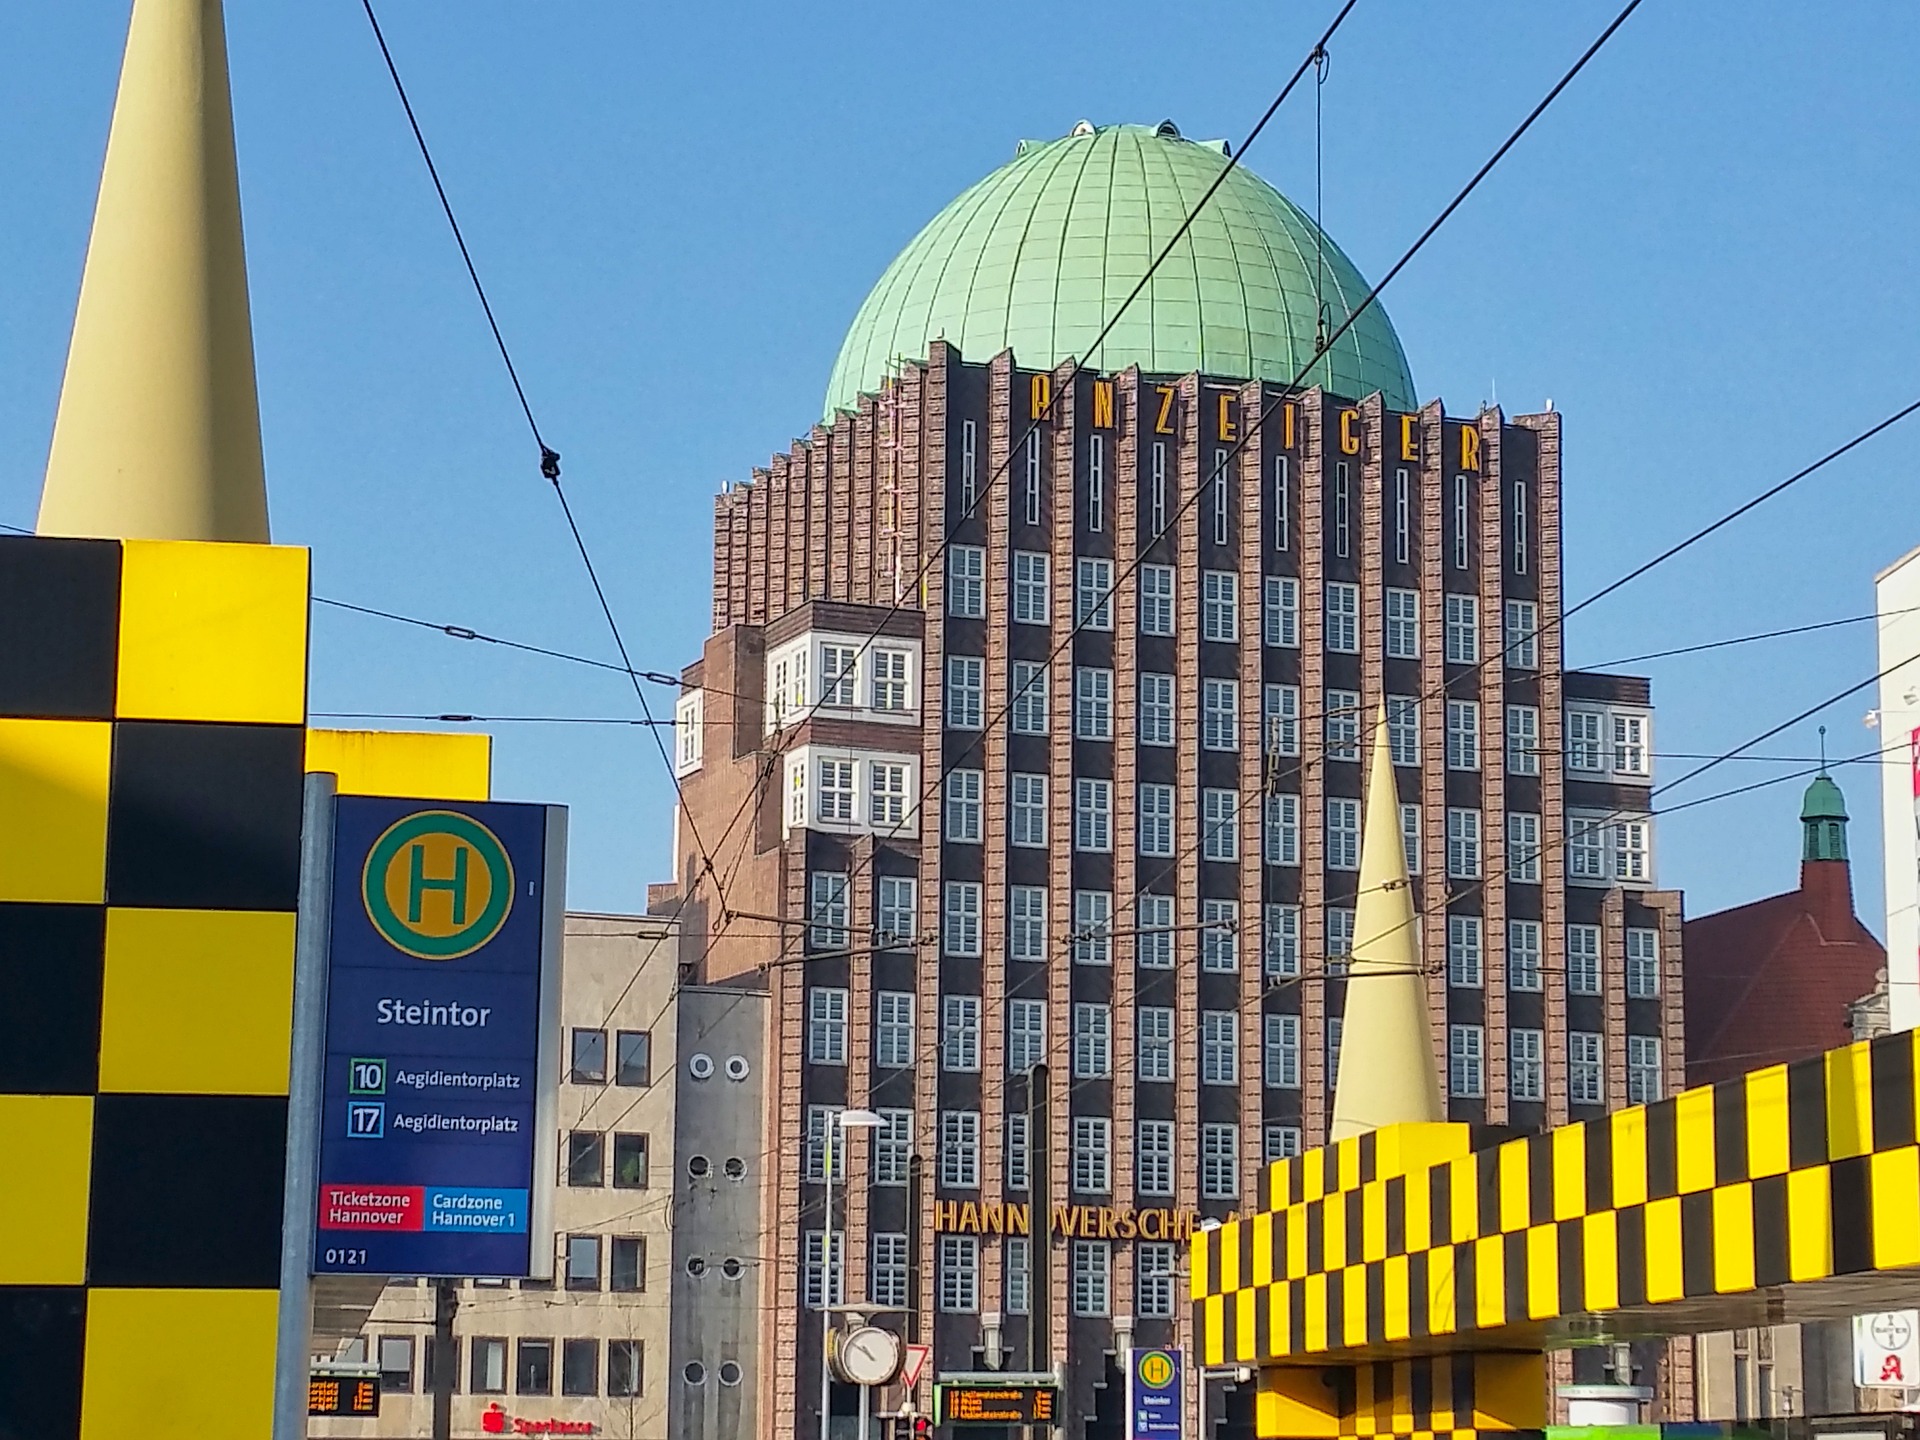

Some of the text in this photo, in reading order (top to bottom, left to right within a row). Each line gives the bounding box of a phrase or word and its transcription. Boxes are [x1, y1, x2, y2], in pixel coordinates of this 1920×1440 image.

[1031, 374, 1480, 471] ANZEIGER
[409, 844, 469, 925] H
[377, 998, 491, 1027] Steintor
[355, 1064, 521, 1091] 10 Aegidientorplatz
[353, 1108, 519, 1135] 17 Aegidientorplatz
[330, 1191, 411, 1208] Ticketzone
[432, 1193, 503, 1211] Cardzone
[329, 1208, 404, 1225] Hannover
[432, 1211, 516, 1228] Hannover 1
[325, 1248, 367, 1265] 0121
